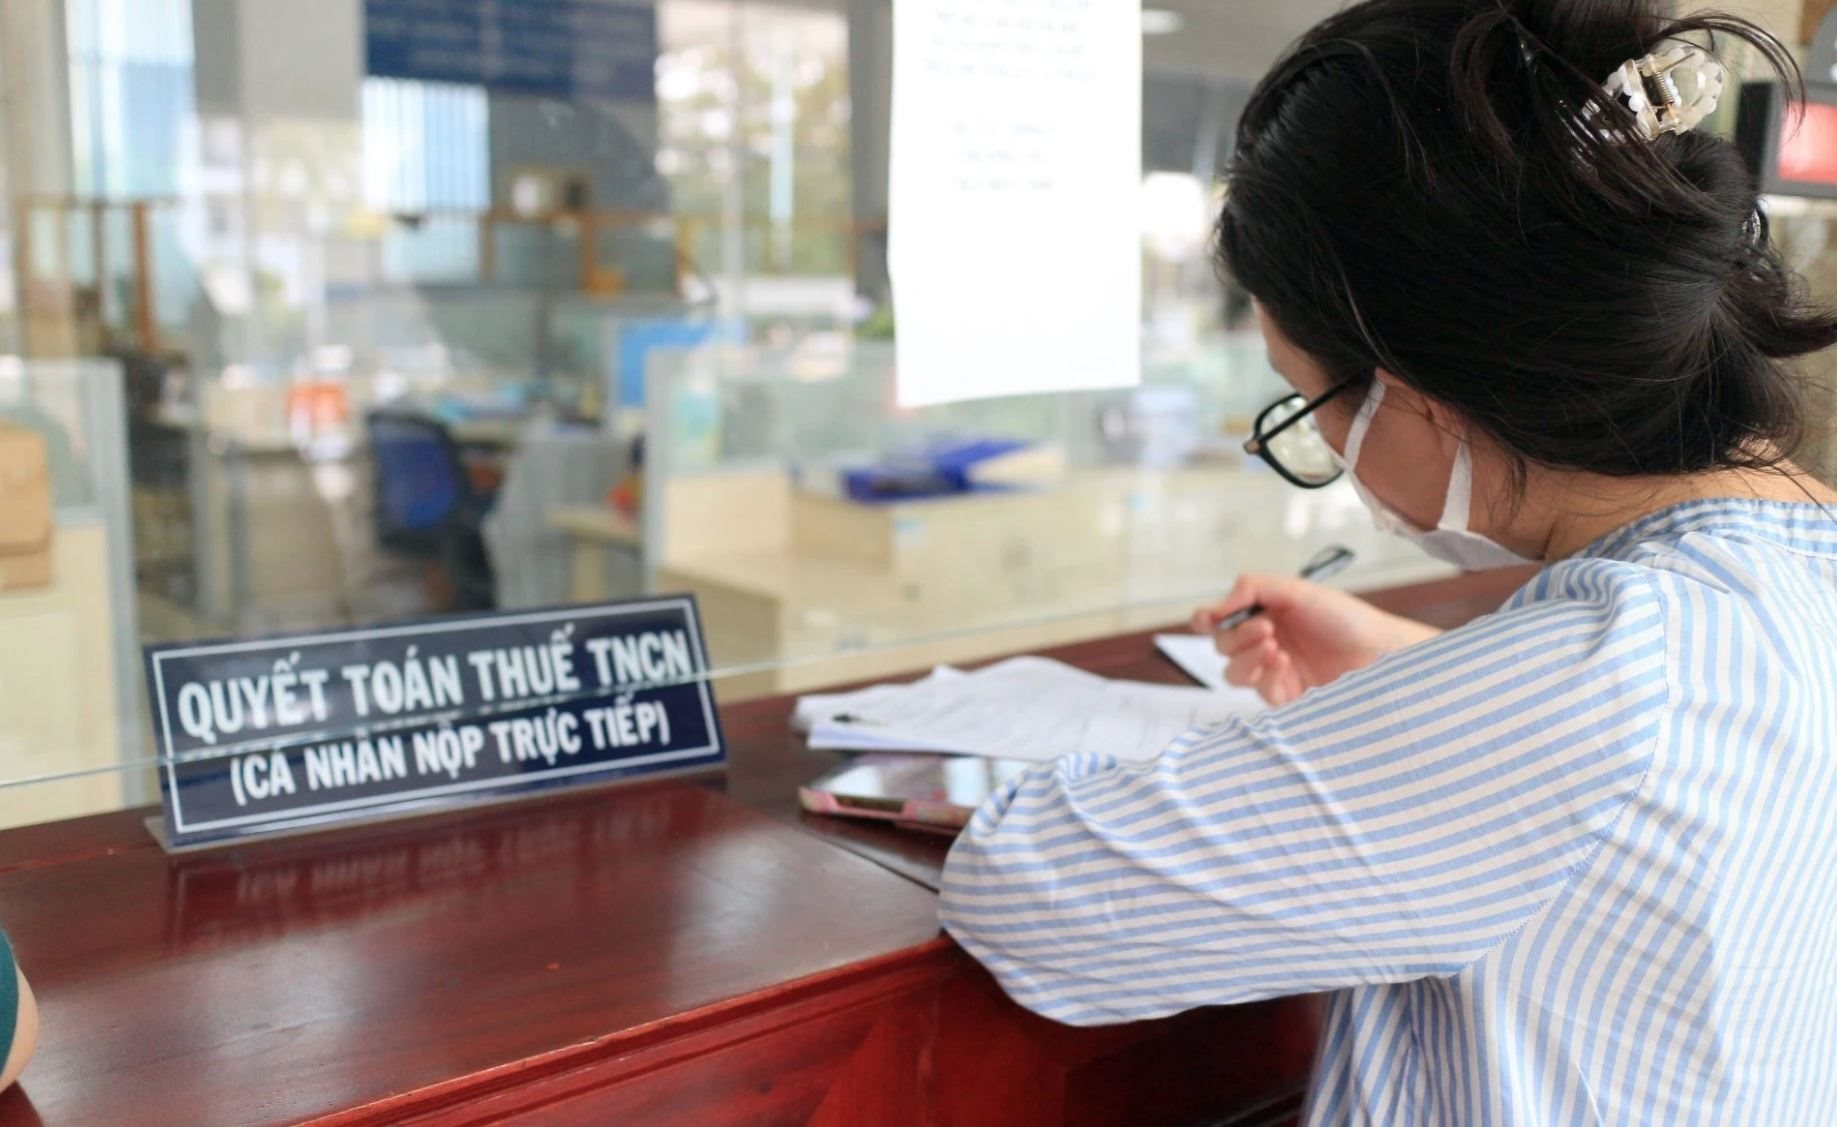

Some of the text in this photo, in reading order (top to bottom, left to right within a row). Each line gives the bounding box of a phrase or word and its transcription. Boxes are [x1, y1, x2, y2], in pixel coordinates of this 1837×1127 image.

[178, 623, 690, 744] QUYẾT TOÁN THUẾ TNCN
[305, 729, 407, 791] NHÂN
[412, 718, 484, 779] NỘP
[490, 707, 581, 766] TRỰC
[583, 691, 670, 748] TIẾP)
